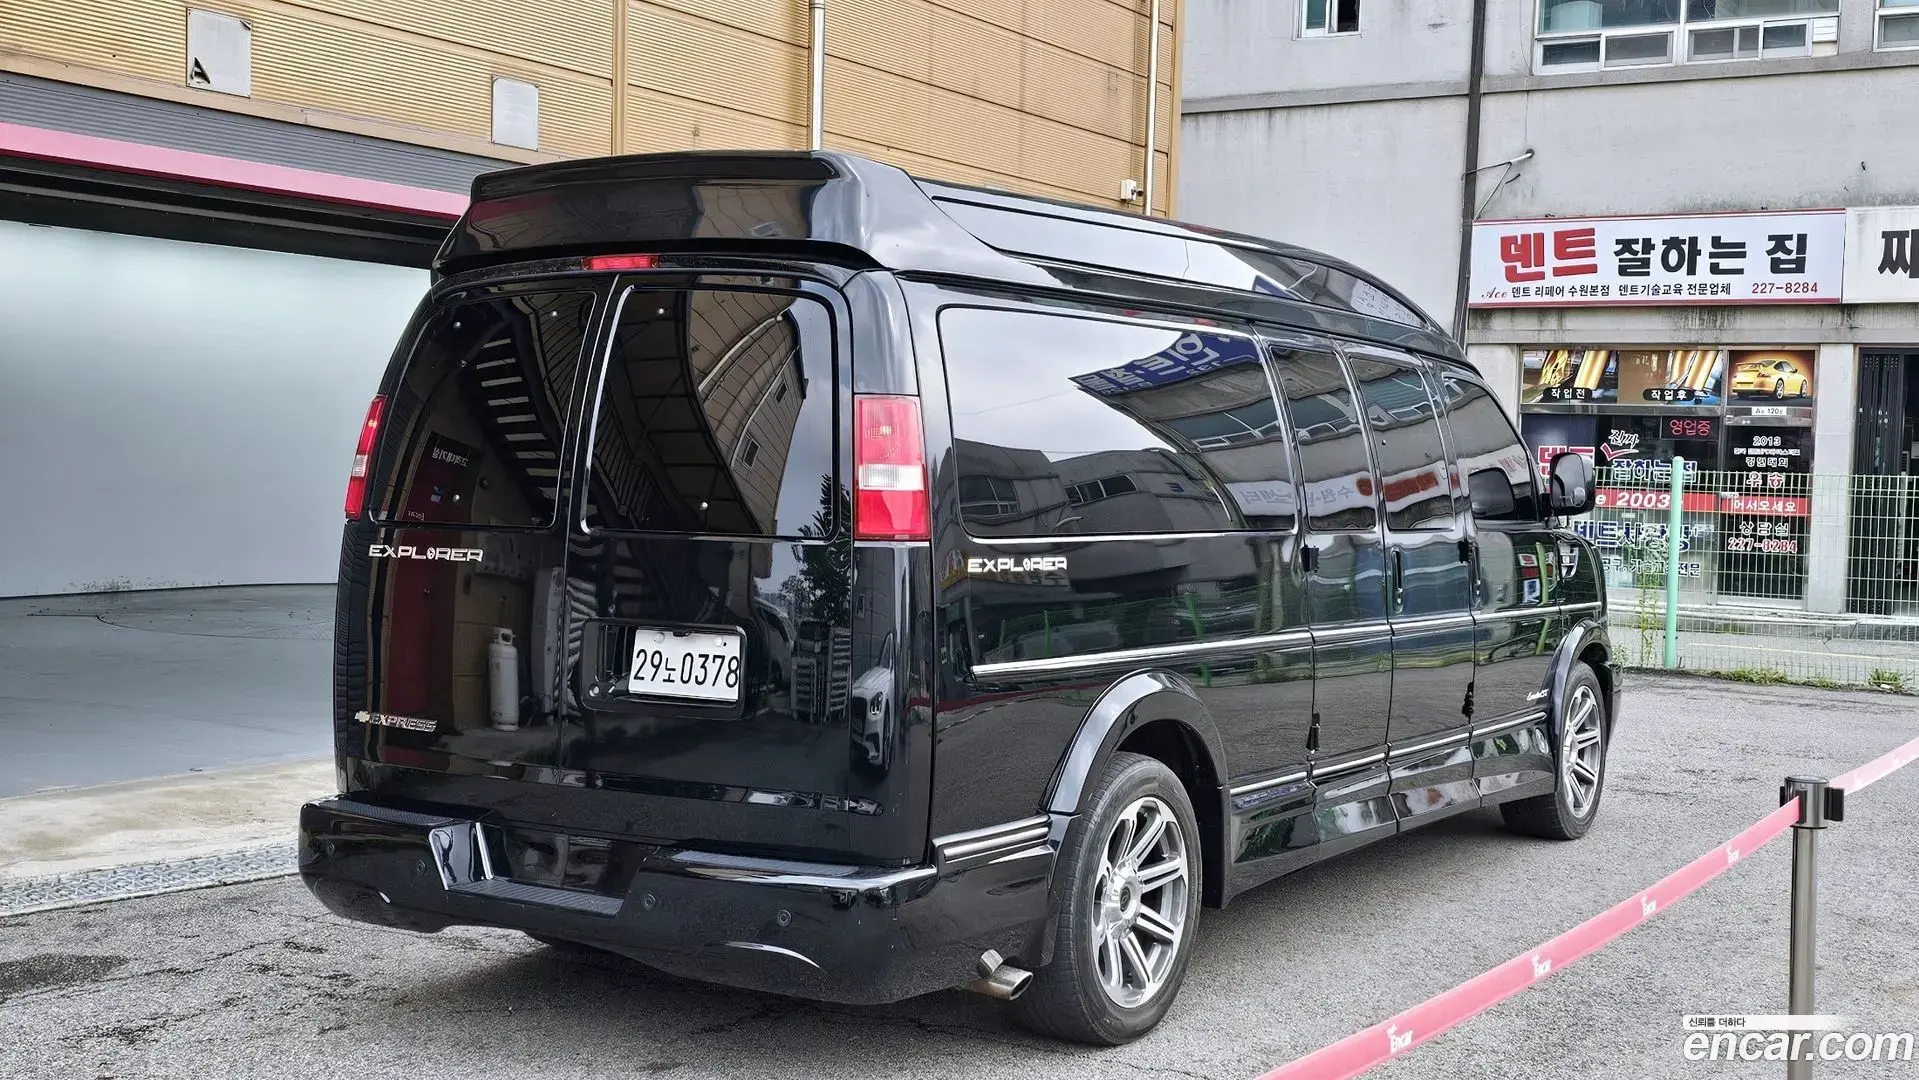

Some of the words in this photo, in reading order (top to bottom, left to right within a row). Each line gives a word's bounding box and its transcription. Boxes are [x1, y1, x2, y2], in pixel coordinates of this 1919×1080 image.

[1500, 228, 1598, 283] 덴트
[1613, 235, 1747, 278] 잘하는
[1765, 233, 1808, 275] 집
[1481, 286, 1507, 299] Ace
[1511, 286, 1531, 298] 덴트
[1535, 285, 1565, 298] 리페어
[1568, 284, 1610, 297] 수원본점
[1687, 283, 1731, 296] 전문업체
[1752, 281, 1818, 295] 227-8284
[1670, 419, 1710, 436] 영업중
[1752, 435, 1781, 447] 2013
[1612, 459, 1672, 482] 잘하는
[1616, 492, 1671, 508] 2003
[1734, 500, 1797, 513] 어서오세요
[1739, 521, 1789, 537] 상담실
[368, 544, 484, 562] EXPLORER
[1727, 537, 1798, 554] 227-8284
[967, 557, 1068, 573] EXPLORER
[633, 648, 740, 688] 29노0378
[371, 712, 438, 733] EXPRESS
